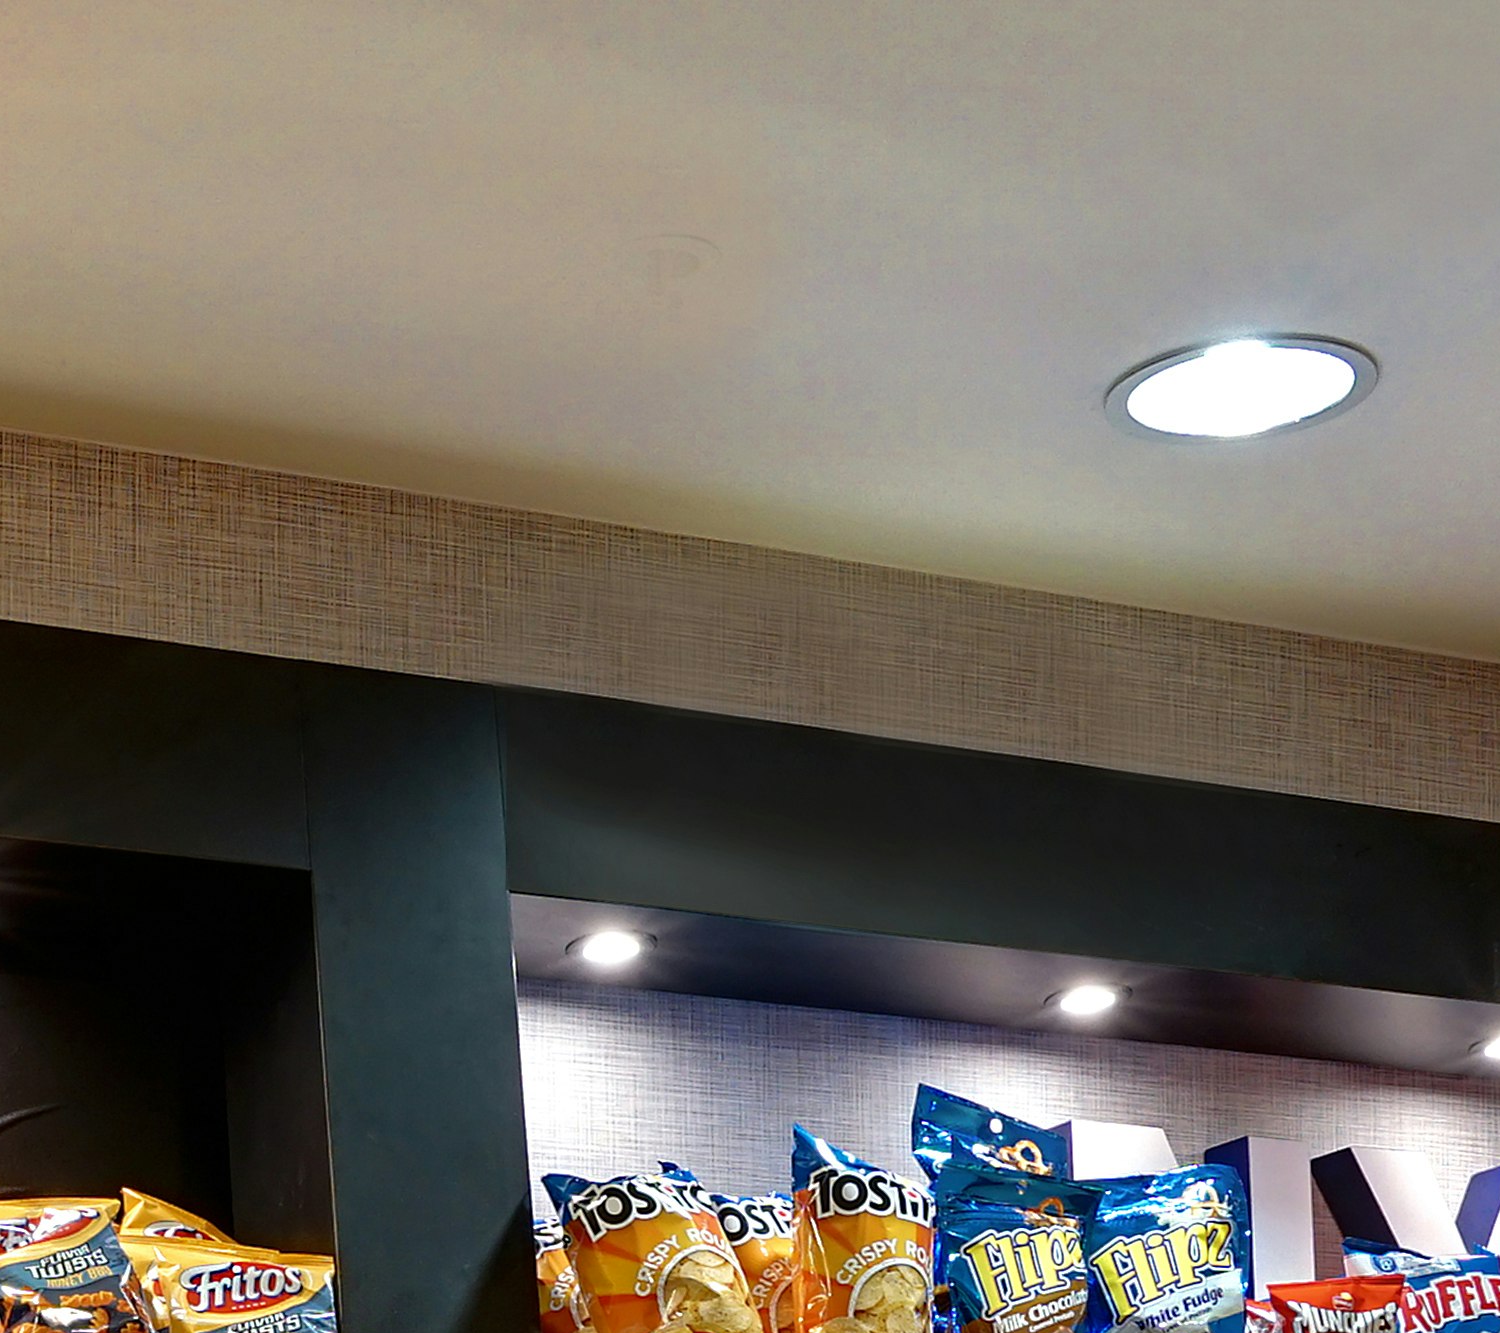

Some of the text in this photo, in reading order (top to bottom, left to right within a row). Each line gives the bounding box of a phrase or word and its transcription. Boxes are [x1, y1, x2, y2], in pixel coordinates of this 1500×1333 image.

[25, 1249, 109, 1280] TWISTS
[634, 1235, 681, 1298] CRISPY
[836, 1237, 899, 1286] CRISPY
[1089, 1221, 1233, 1326] Flipz
[181, 1261, 303, 1313] Fritos
[1182, 1284, 1225, 1314] Fudge
